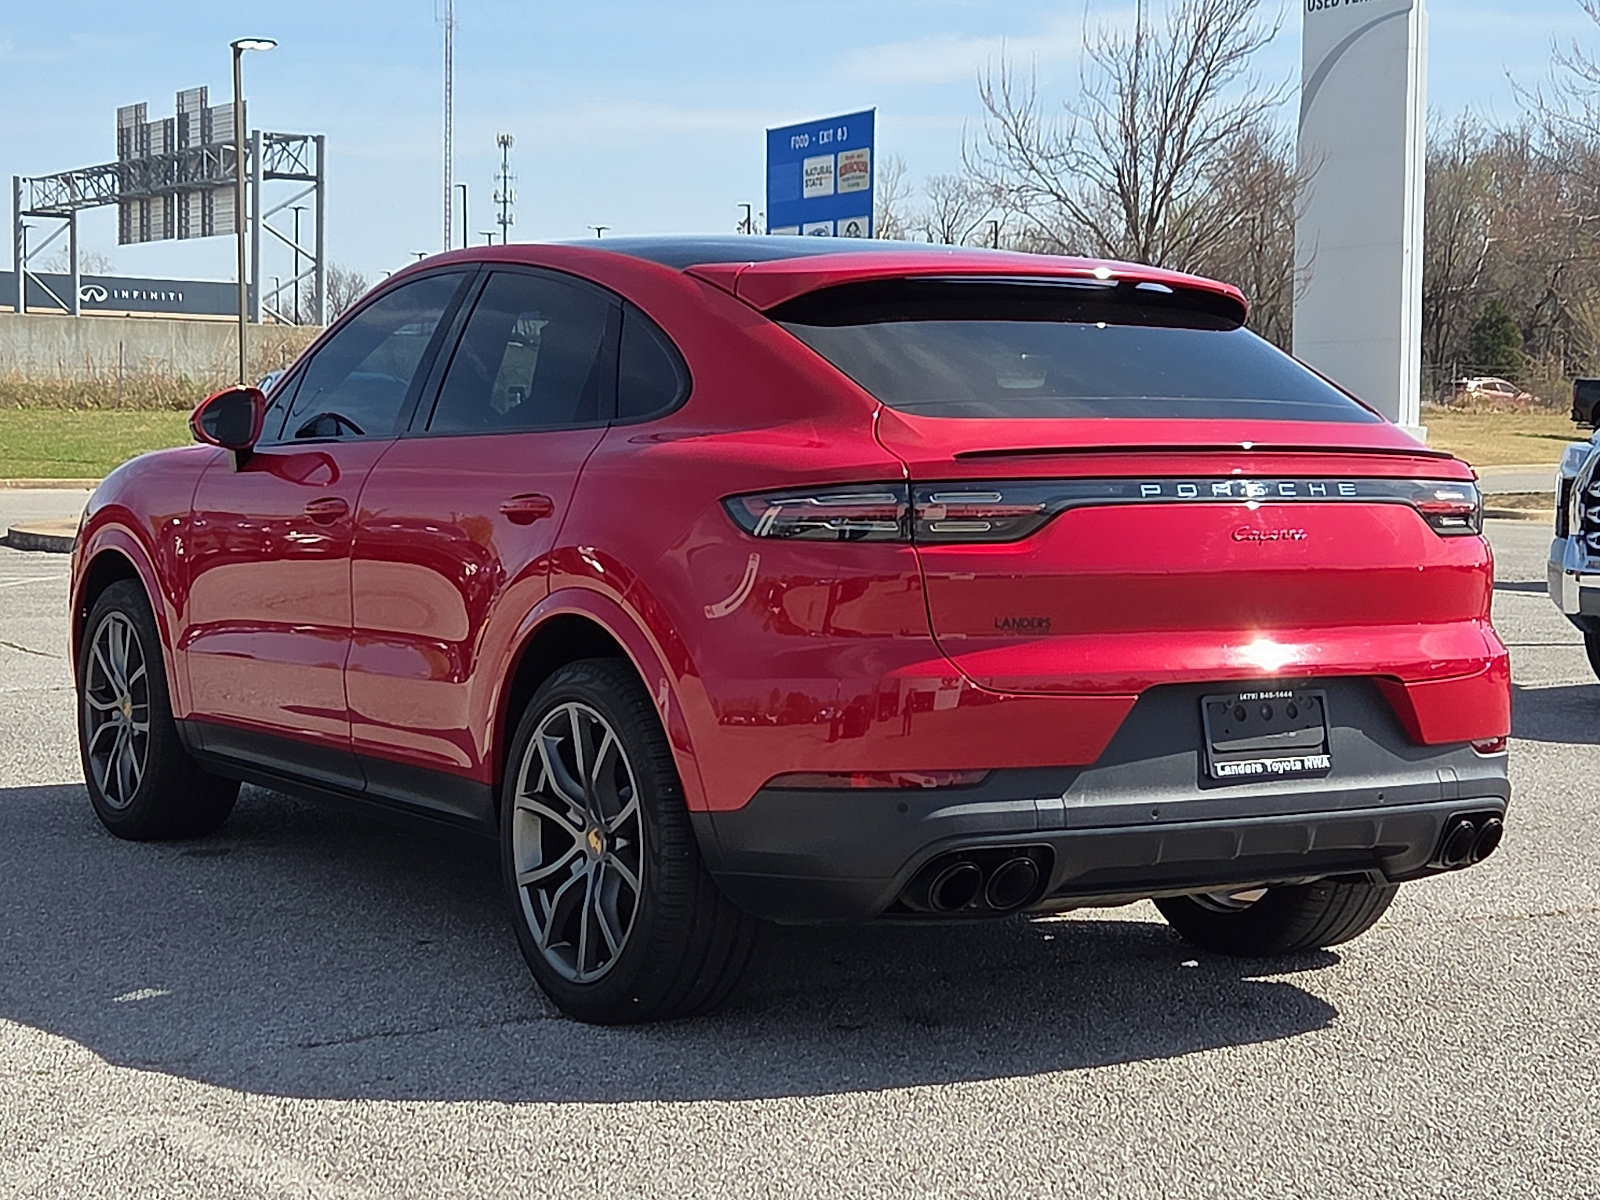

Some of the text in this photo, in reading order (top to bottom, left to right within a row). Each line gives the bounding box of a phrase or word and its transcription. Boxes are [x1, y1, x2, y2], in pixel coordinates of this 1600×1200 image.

[791, 133, 809, 149] FOOD
[819, 129, 833, 144] EXIT
[805, 177, 823, 188] STATE
[114, 289, 183, 302] INFINITI
[1140, 483, 1357, 497] PORSCHE
[995, 616, 1052, 629] LANDERS
[1217, 757, 1331, 775] Landers Toyota NWA
